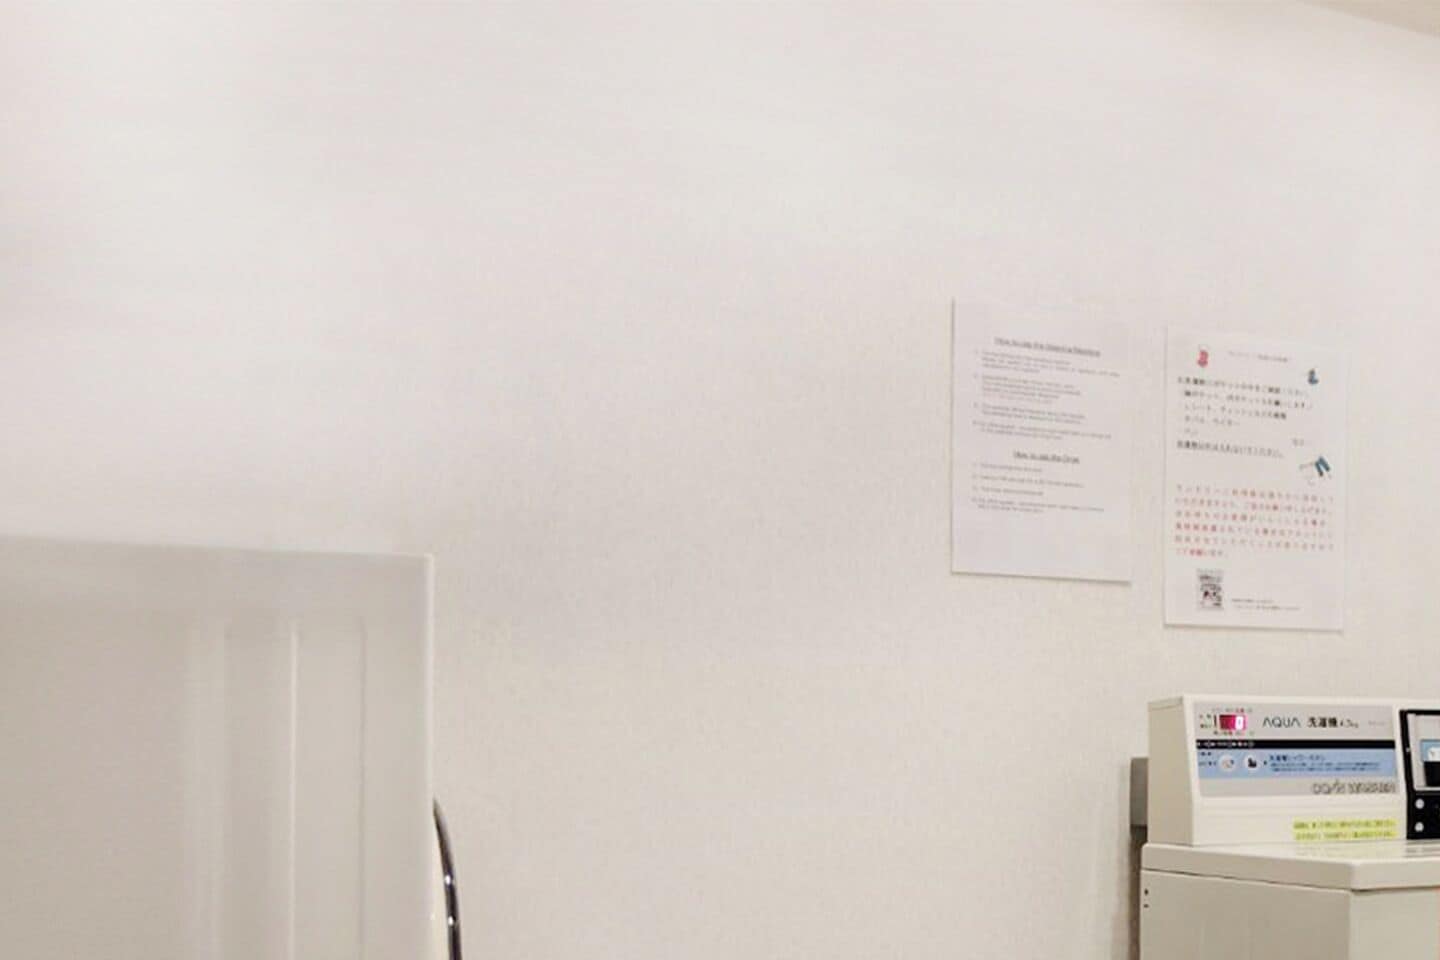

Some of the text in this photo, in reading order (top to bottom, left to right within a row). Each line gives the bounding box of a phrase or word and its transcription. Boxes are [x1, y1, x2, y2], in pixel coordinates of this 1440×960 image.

[1262, 716, 1300, 728] AQUA
[1307, 716, 1338, 729] 洗濯機
